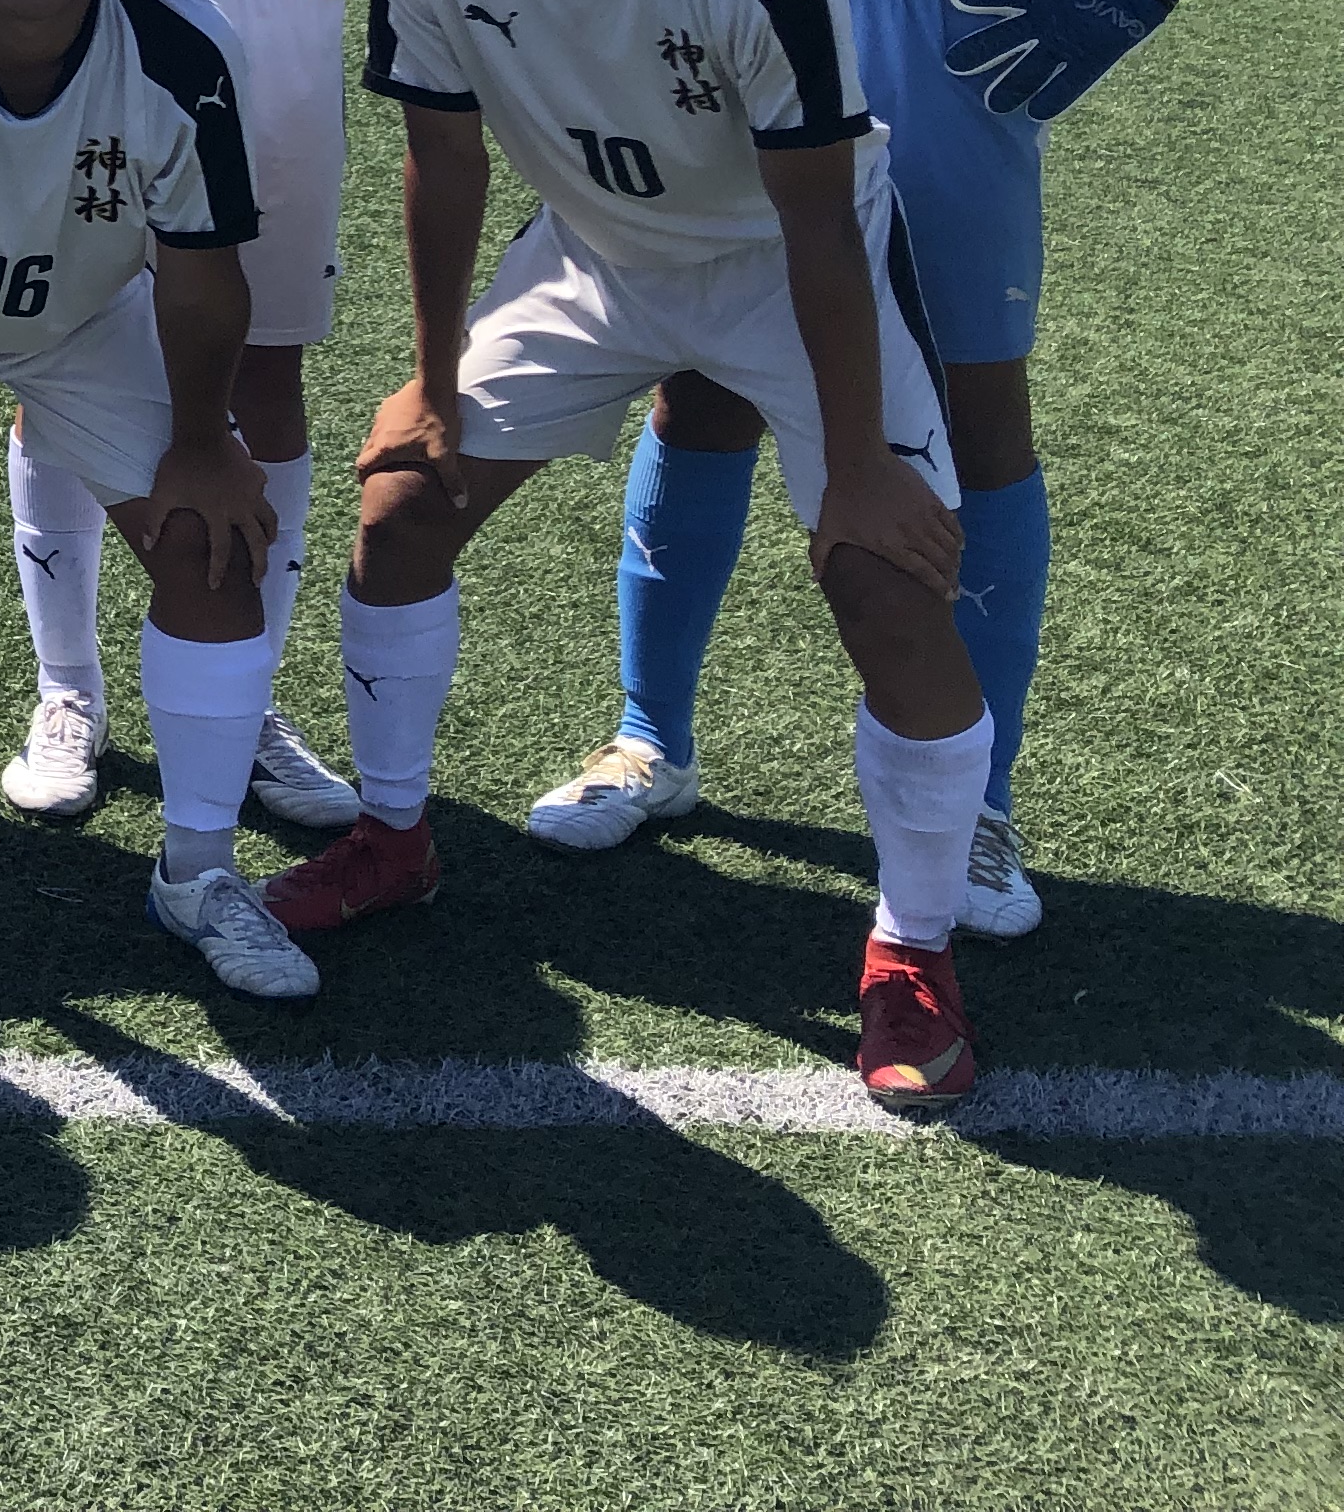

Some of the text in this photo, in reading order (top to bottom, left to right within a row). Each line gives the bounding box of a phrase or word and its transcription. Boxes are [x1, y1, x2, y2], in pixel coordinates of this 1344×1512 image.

[656, 27, 722, 116] 神村
[73, 135, 128, 224] 神村
[565, 127, 666, 199] 10
